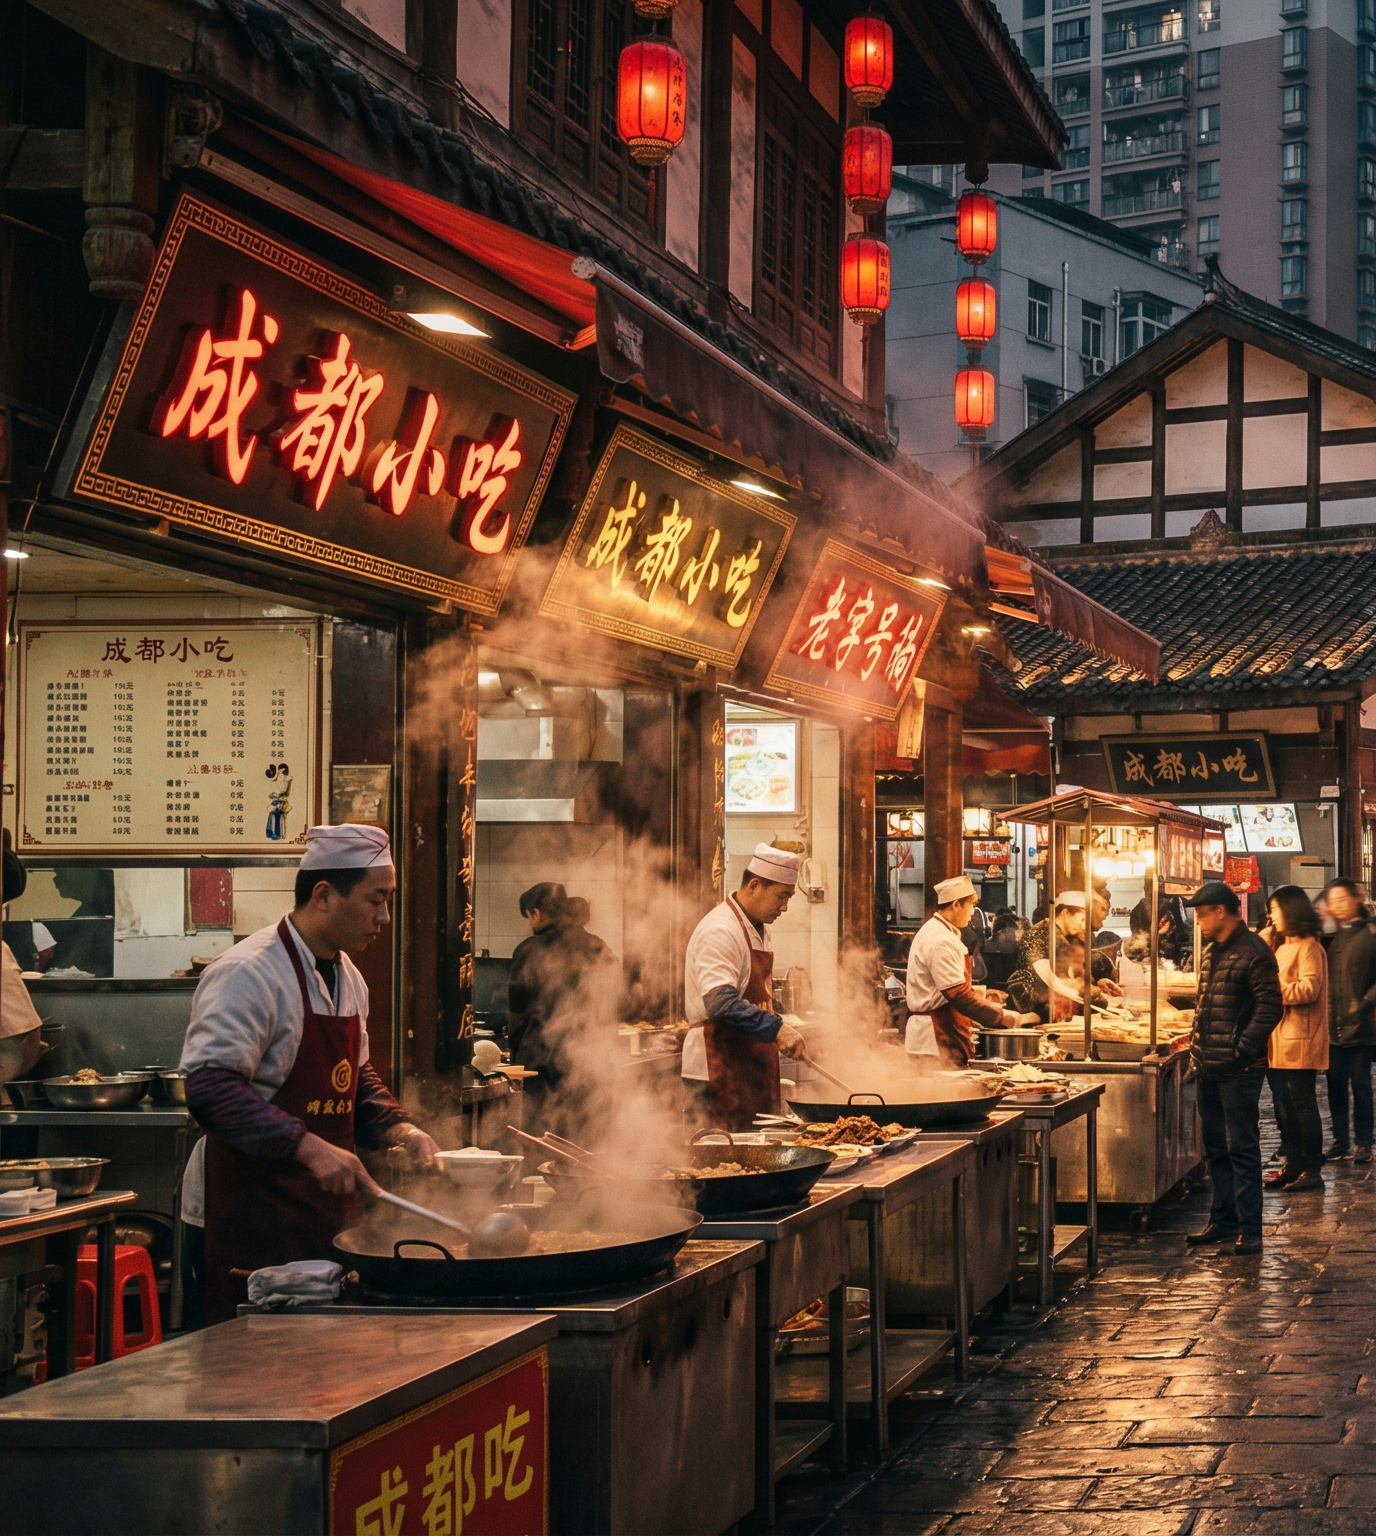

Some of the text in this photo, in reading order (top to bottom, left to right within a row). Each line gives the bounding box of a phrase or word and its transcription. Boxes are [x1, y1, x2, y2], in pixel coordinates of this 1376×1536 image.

[162, 289, 520, 555] 成都小吃
[586, 480, 762, 628] 成都小吃
[101, 635, 235, 664] 成都小吃
[1123, 747, 1259, 787] 成都小吃
[355, 1404, 534, 1536] 成都吃
